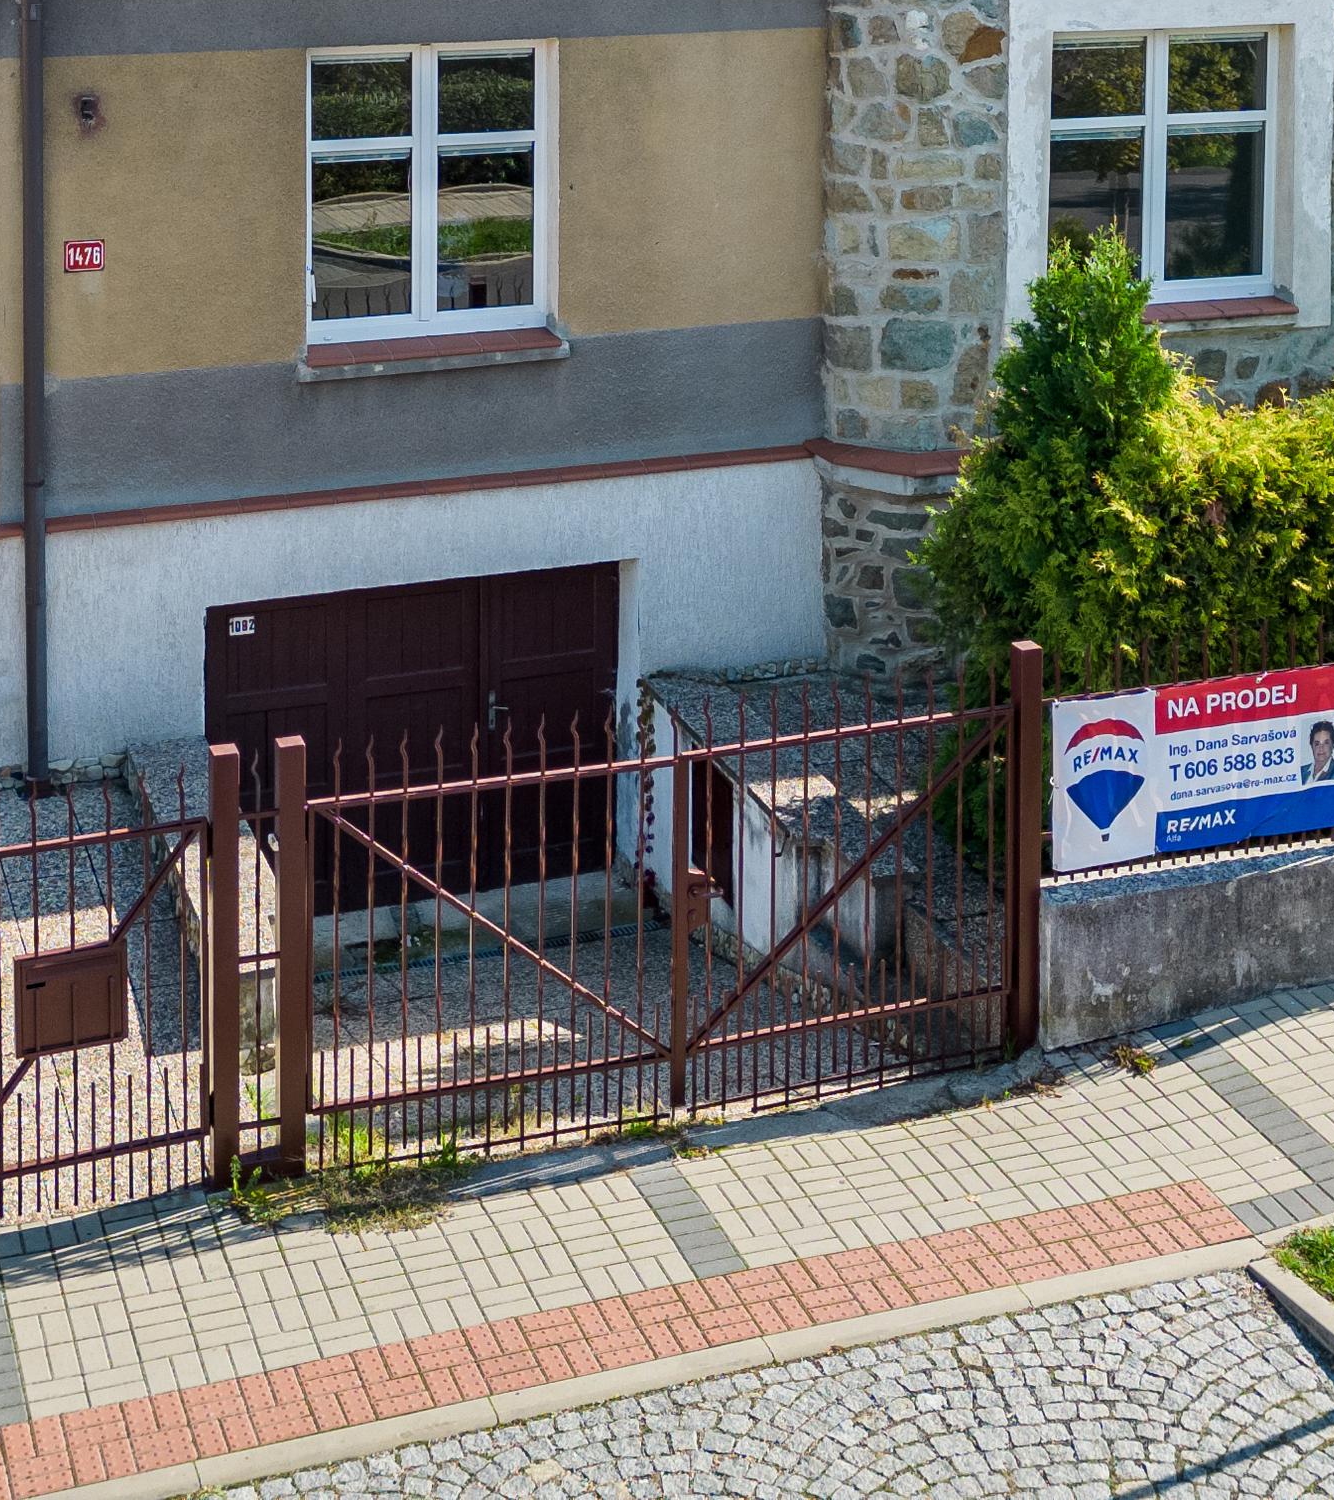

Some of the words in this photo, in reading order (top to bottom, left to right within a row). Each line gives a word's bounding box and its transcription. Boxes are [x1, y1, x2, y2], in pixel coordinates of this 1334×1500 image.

[68, 246, 101, 266] 1476
[1167, 696, 1200, 719] NA
[1206, 684, 1297, 714] PRODEJ
[1073, 746, 1139, 772] RE/MAX
[1169, 744, 1191, 756] Ing.
[1196, 738, 1228, 752] Dana
[1169, 764, 1181, 782] T
[1185, 758, 1218, 779] 606
[1223, 753, 1256, 772] 588
[1262, 747, 1295, 767] 833
[1166, 809, 1236, 834] RE/MAX
